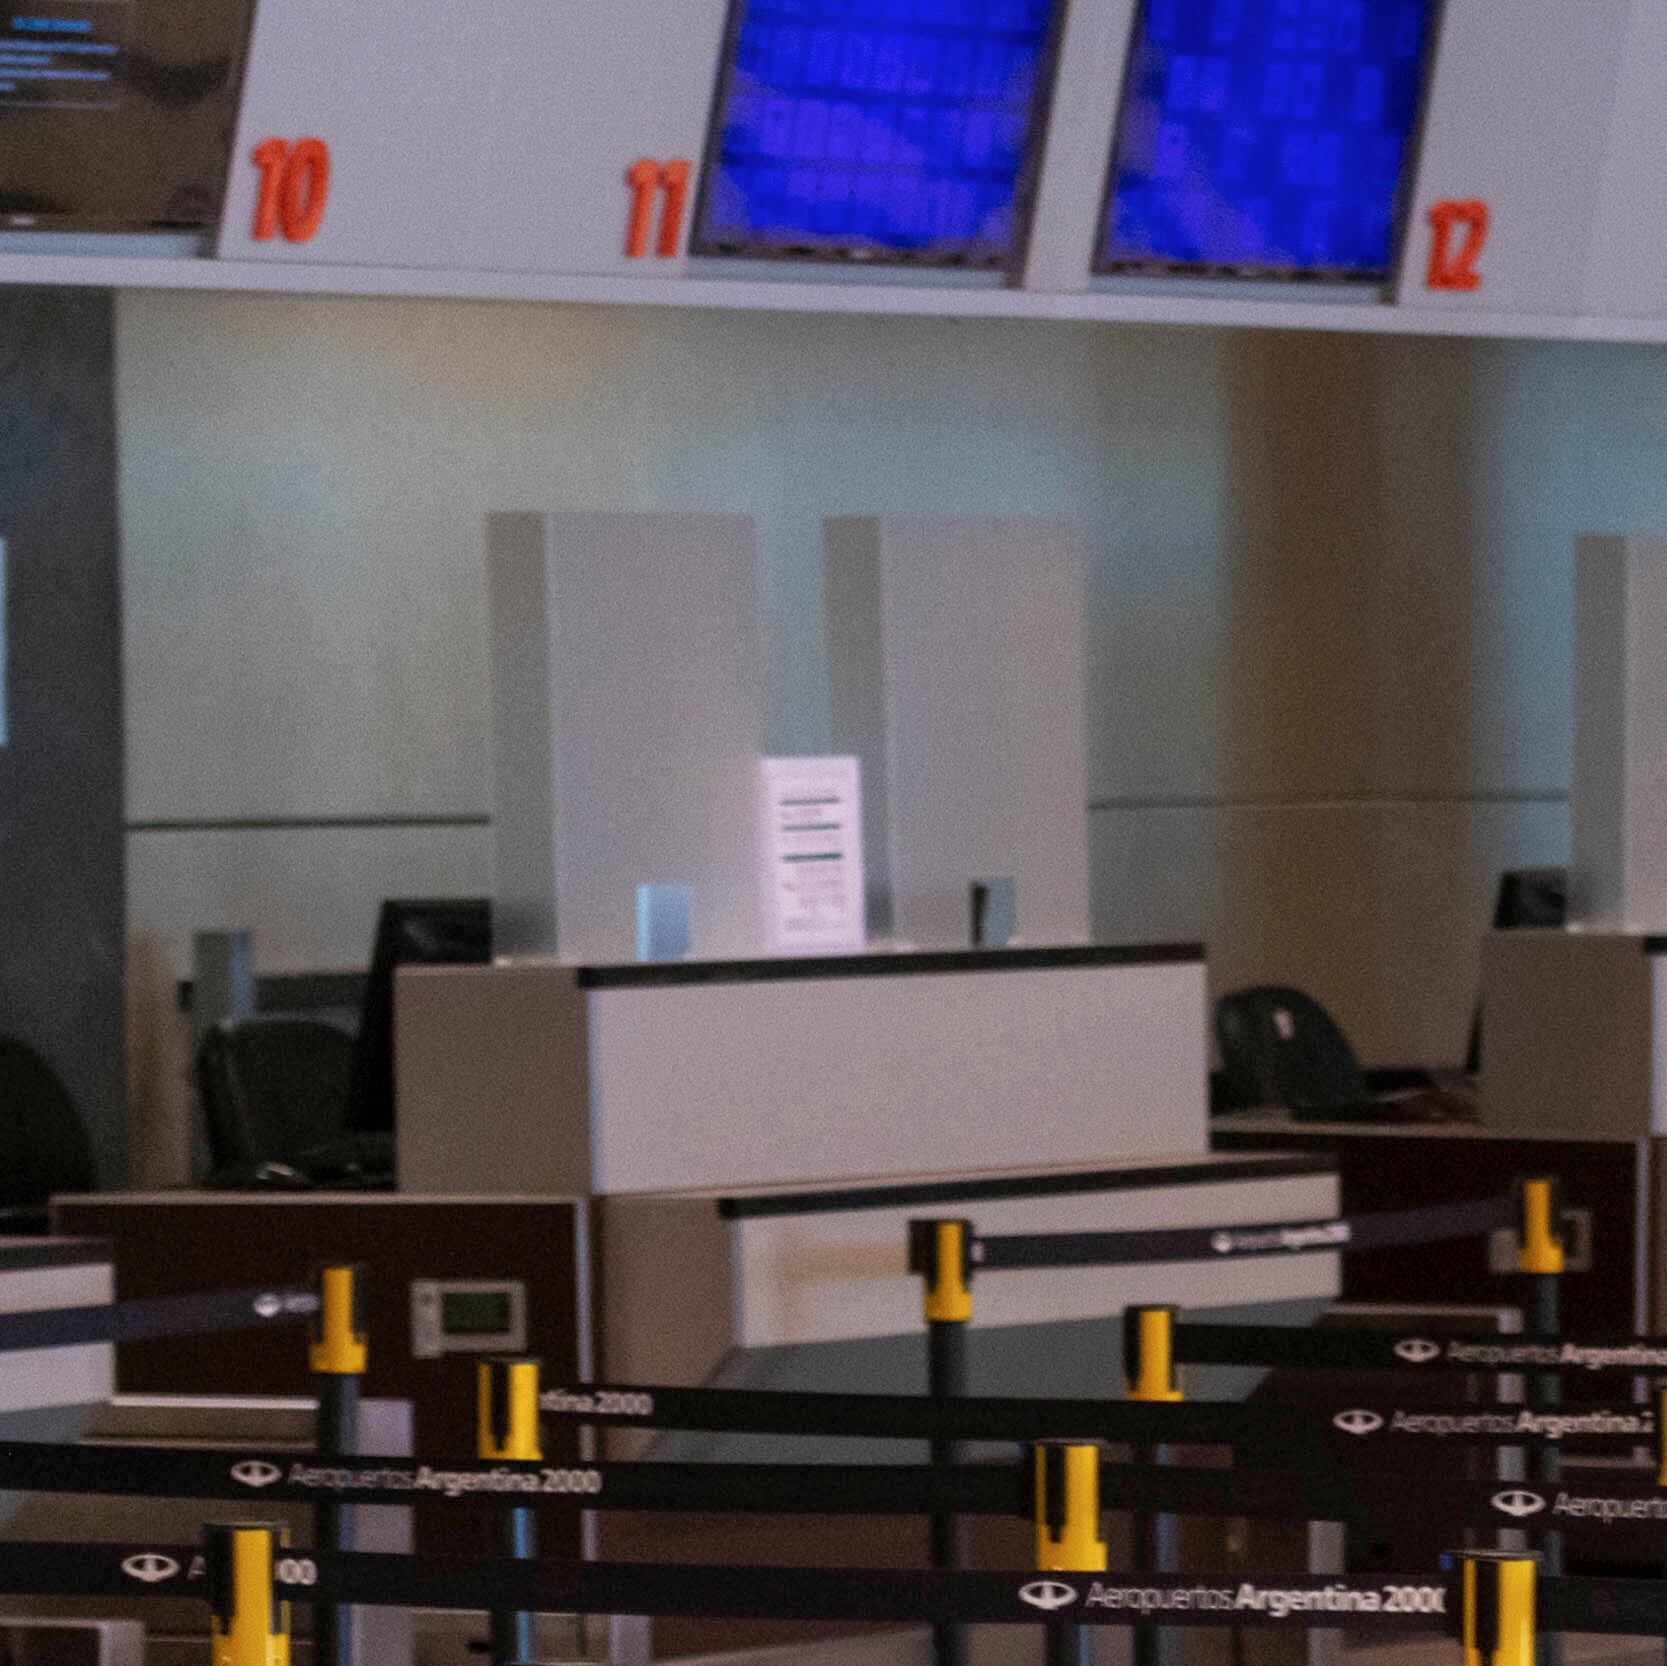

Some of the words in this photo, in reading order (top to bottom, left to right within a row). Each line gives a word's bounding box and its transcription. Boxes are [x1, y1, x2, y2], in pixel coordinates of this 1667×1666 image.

[251, 136, 331, 243] 10
[624, 158, 690, 258] 11
[1426, 198, 1489, 292] 12
[541, 1470, 603, 1493] 2000
[1086, 1581, 1239, 1615] Aeropuertos
[1237, 1582, 1382, 1618] Argentina
